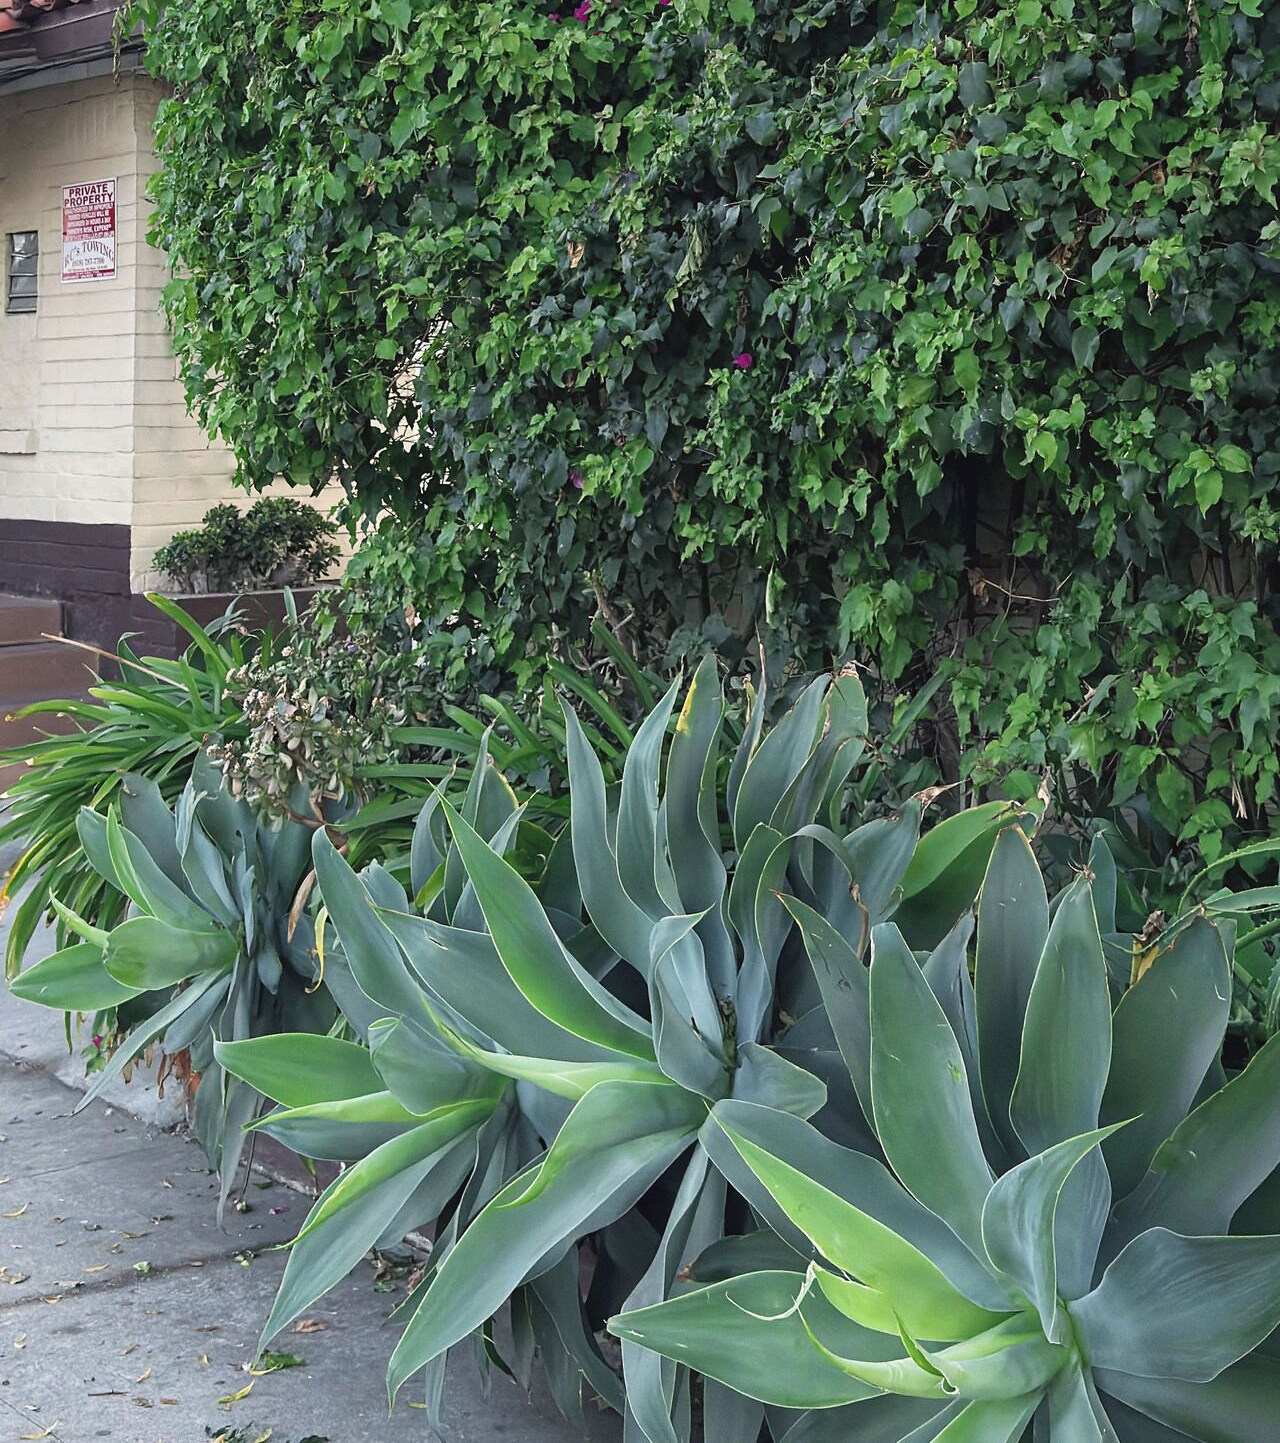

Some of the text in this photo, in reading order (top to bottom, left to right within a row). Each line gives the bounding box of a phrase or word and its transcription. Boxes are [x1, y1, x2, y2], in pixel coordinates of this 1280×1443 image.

[69, 183, 108, 198] PRIVATE
[64, 192, 113, 208] PROPERTY
[82, 240, 114, 262] TOWING
